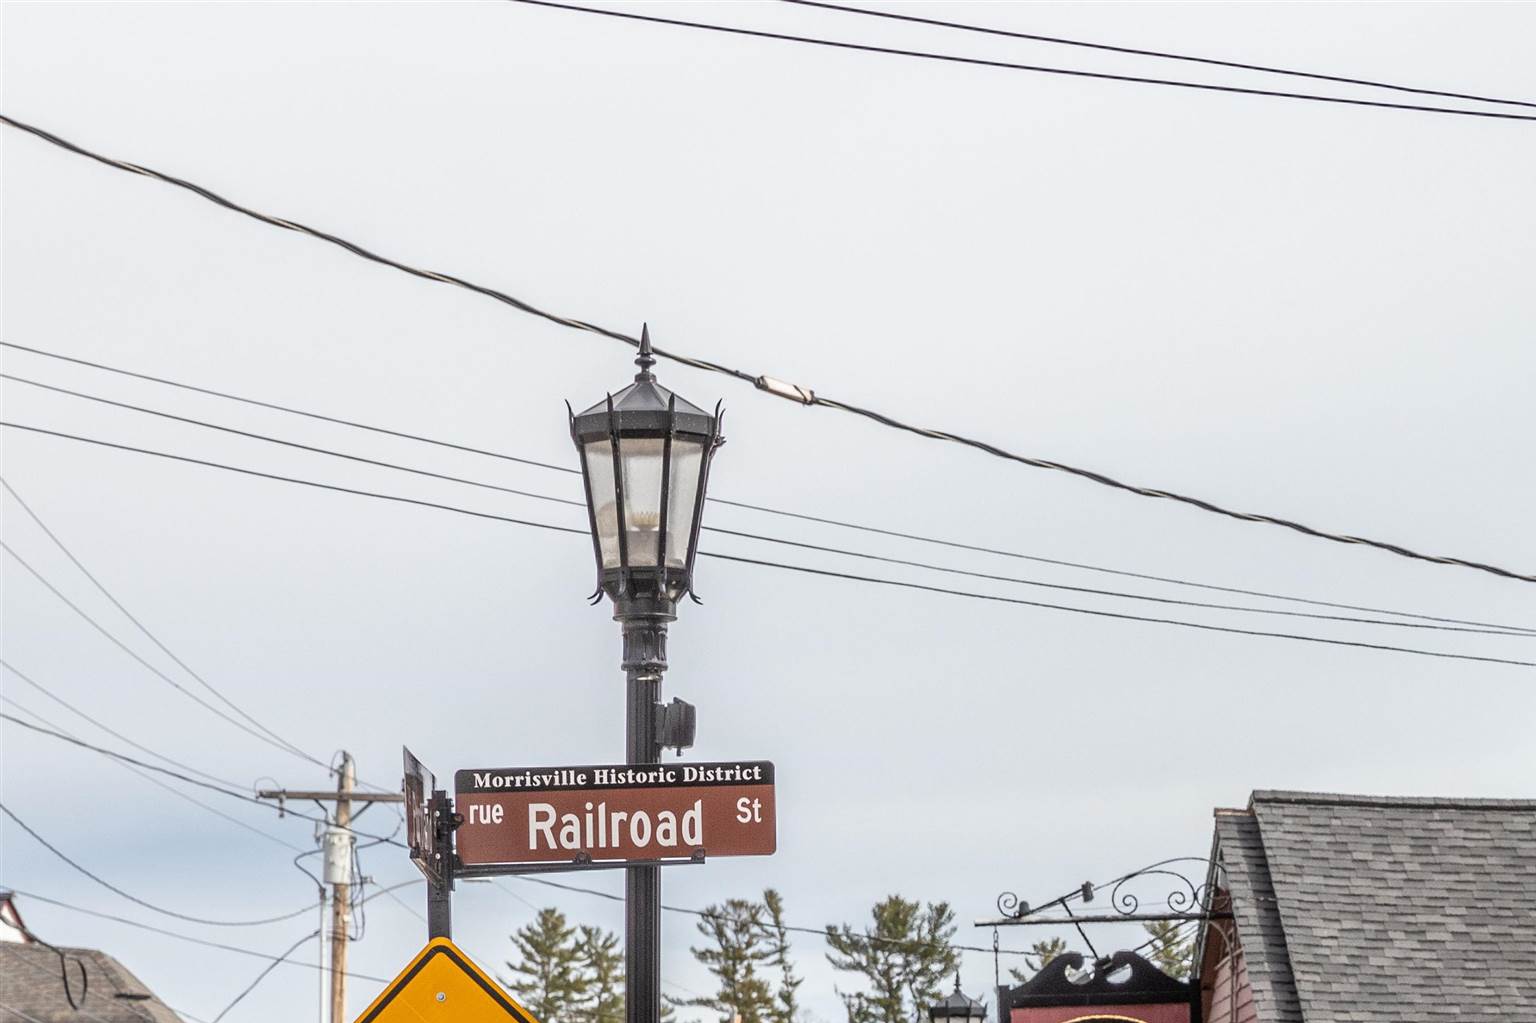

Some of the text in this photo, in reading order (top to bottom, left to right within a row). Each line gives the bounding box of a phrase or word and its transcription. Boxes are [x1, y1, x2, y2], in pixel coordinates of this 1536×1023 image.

[473, 765, 762, 789] Morrisville Historic District
[469, 797, 762, 850] rue Railroad St
